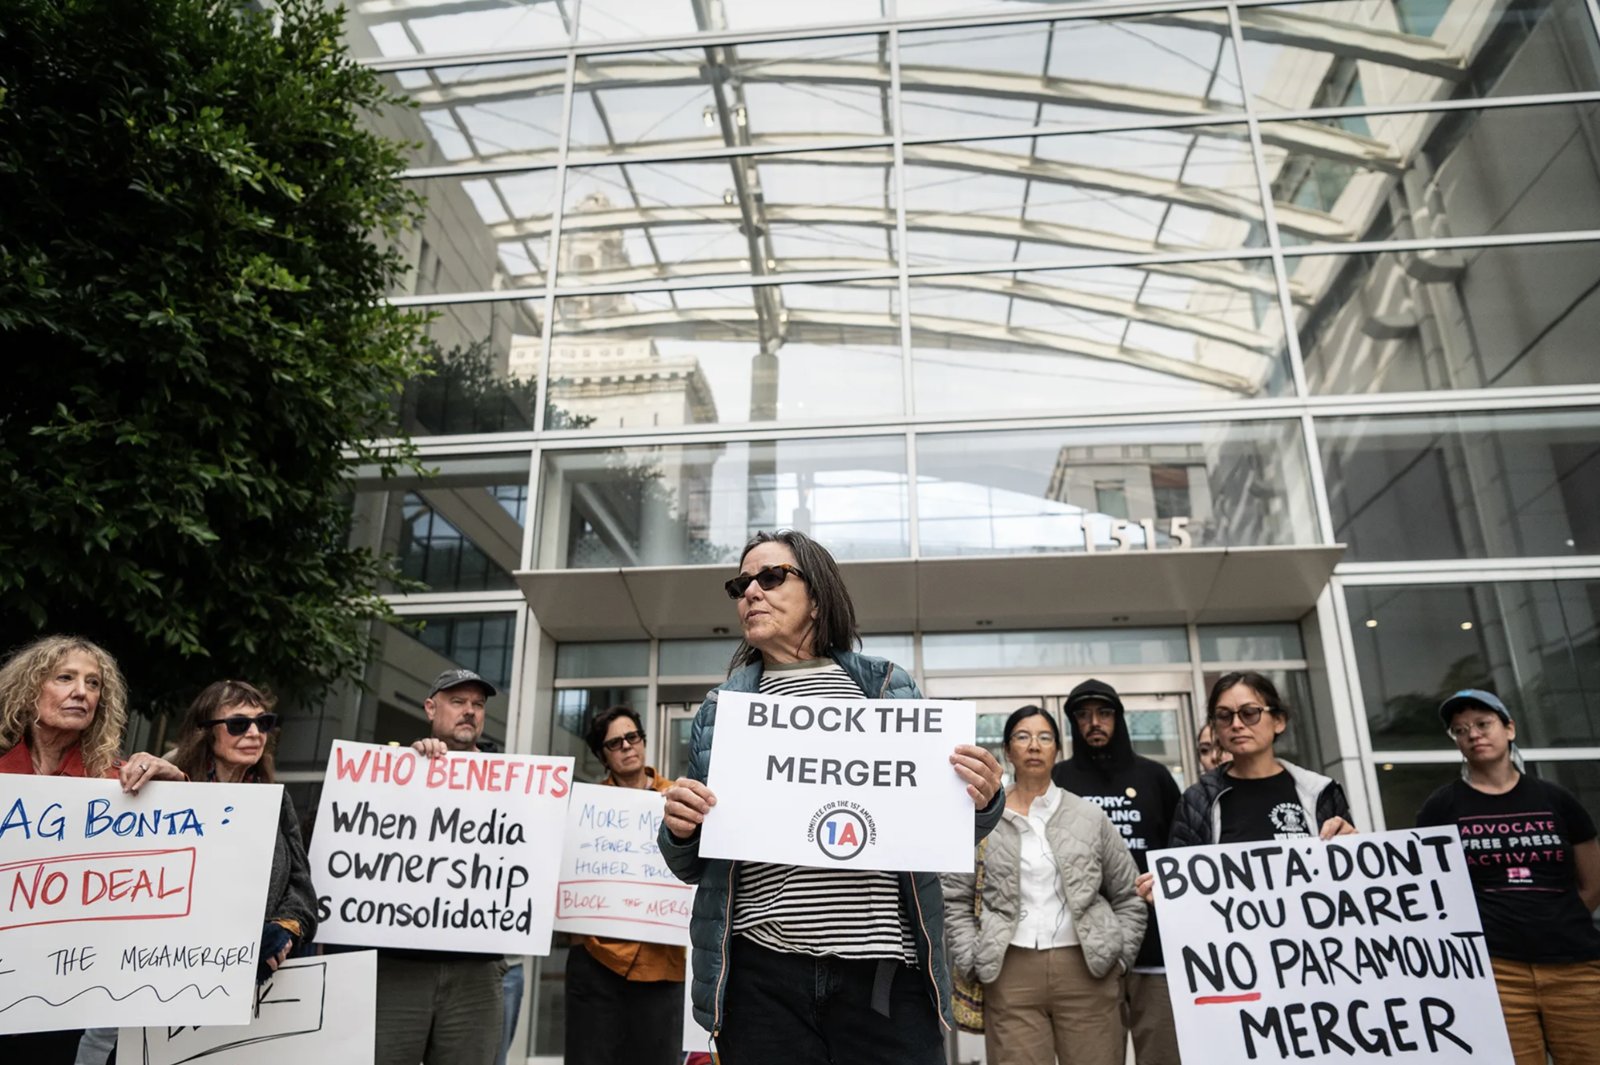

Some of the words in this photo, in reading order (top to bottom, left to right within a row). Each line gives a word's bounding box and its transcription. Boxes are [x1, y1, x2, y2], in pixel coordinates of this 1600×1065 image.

[1080, 516, 1192, 552] 1515
[747, 701, 866, 733] BLOCK
[875, 707, 943, 733] THE
[336, 747, 416, 786] WHO
[426, 755, 570, 798] BENEFITS
[766, 755, 917, 787] MERGER
[0, 798, 66, 841] AG
[332, 801, 417, 840] When
[428, 806, 527, 845] Media
[579, 803, 631, 830] MORE
[807, 808, 825, 843] COMMITTEE
[823, 801, 836, 812] FOR
[850, 802, 861, 810] 1ST
[860, 808, 877, 846] AMENDMENT
[826, 821, 858, 846] 1A
[1460, 821, 1555, 836] ADVOCATE
[1326, 831, 1457, 882] DON'T
[1461, 838, 1502, 850] FREE
[1508, 834, 1562, 847] PRESS
[1467, 850, 1564, 865] ACTIVATE
[328, 850, 528, 908] ownership
[575, 857, 636, 875] HIGHER
[642, 863, 675, 879] PRIC
[9, 862, 68, 912] NO
[81, 866, 185, 906] DEAL
[562, 889, 611, 909] BLOCK
[646, 899, 689, 917] MERG
[340, 896, 532, 935] consolidated
[1211, 896, 1286, 933] YOU
[1302, 879, 1448, 929] DARE!
[48, 946, 97, 976] THE
[121, 942, 256, 973] MEGAMERGER!
[1182, 941, 1258, 993] NO
[1270, 931, 1486, 989] PARAMOUNT
[1240, 997, 1473, 1060] MERGER
